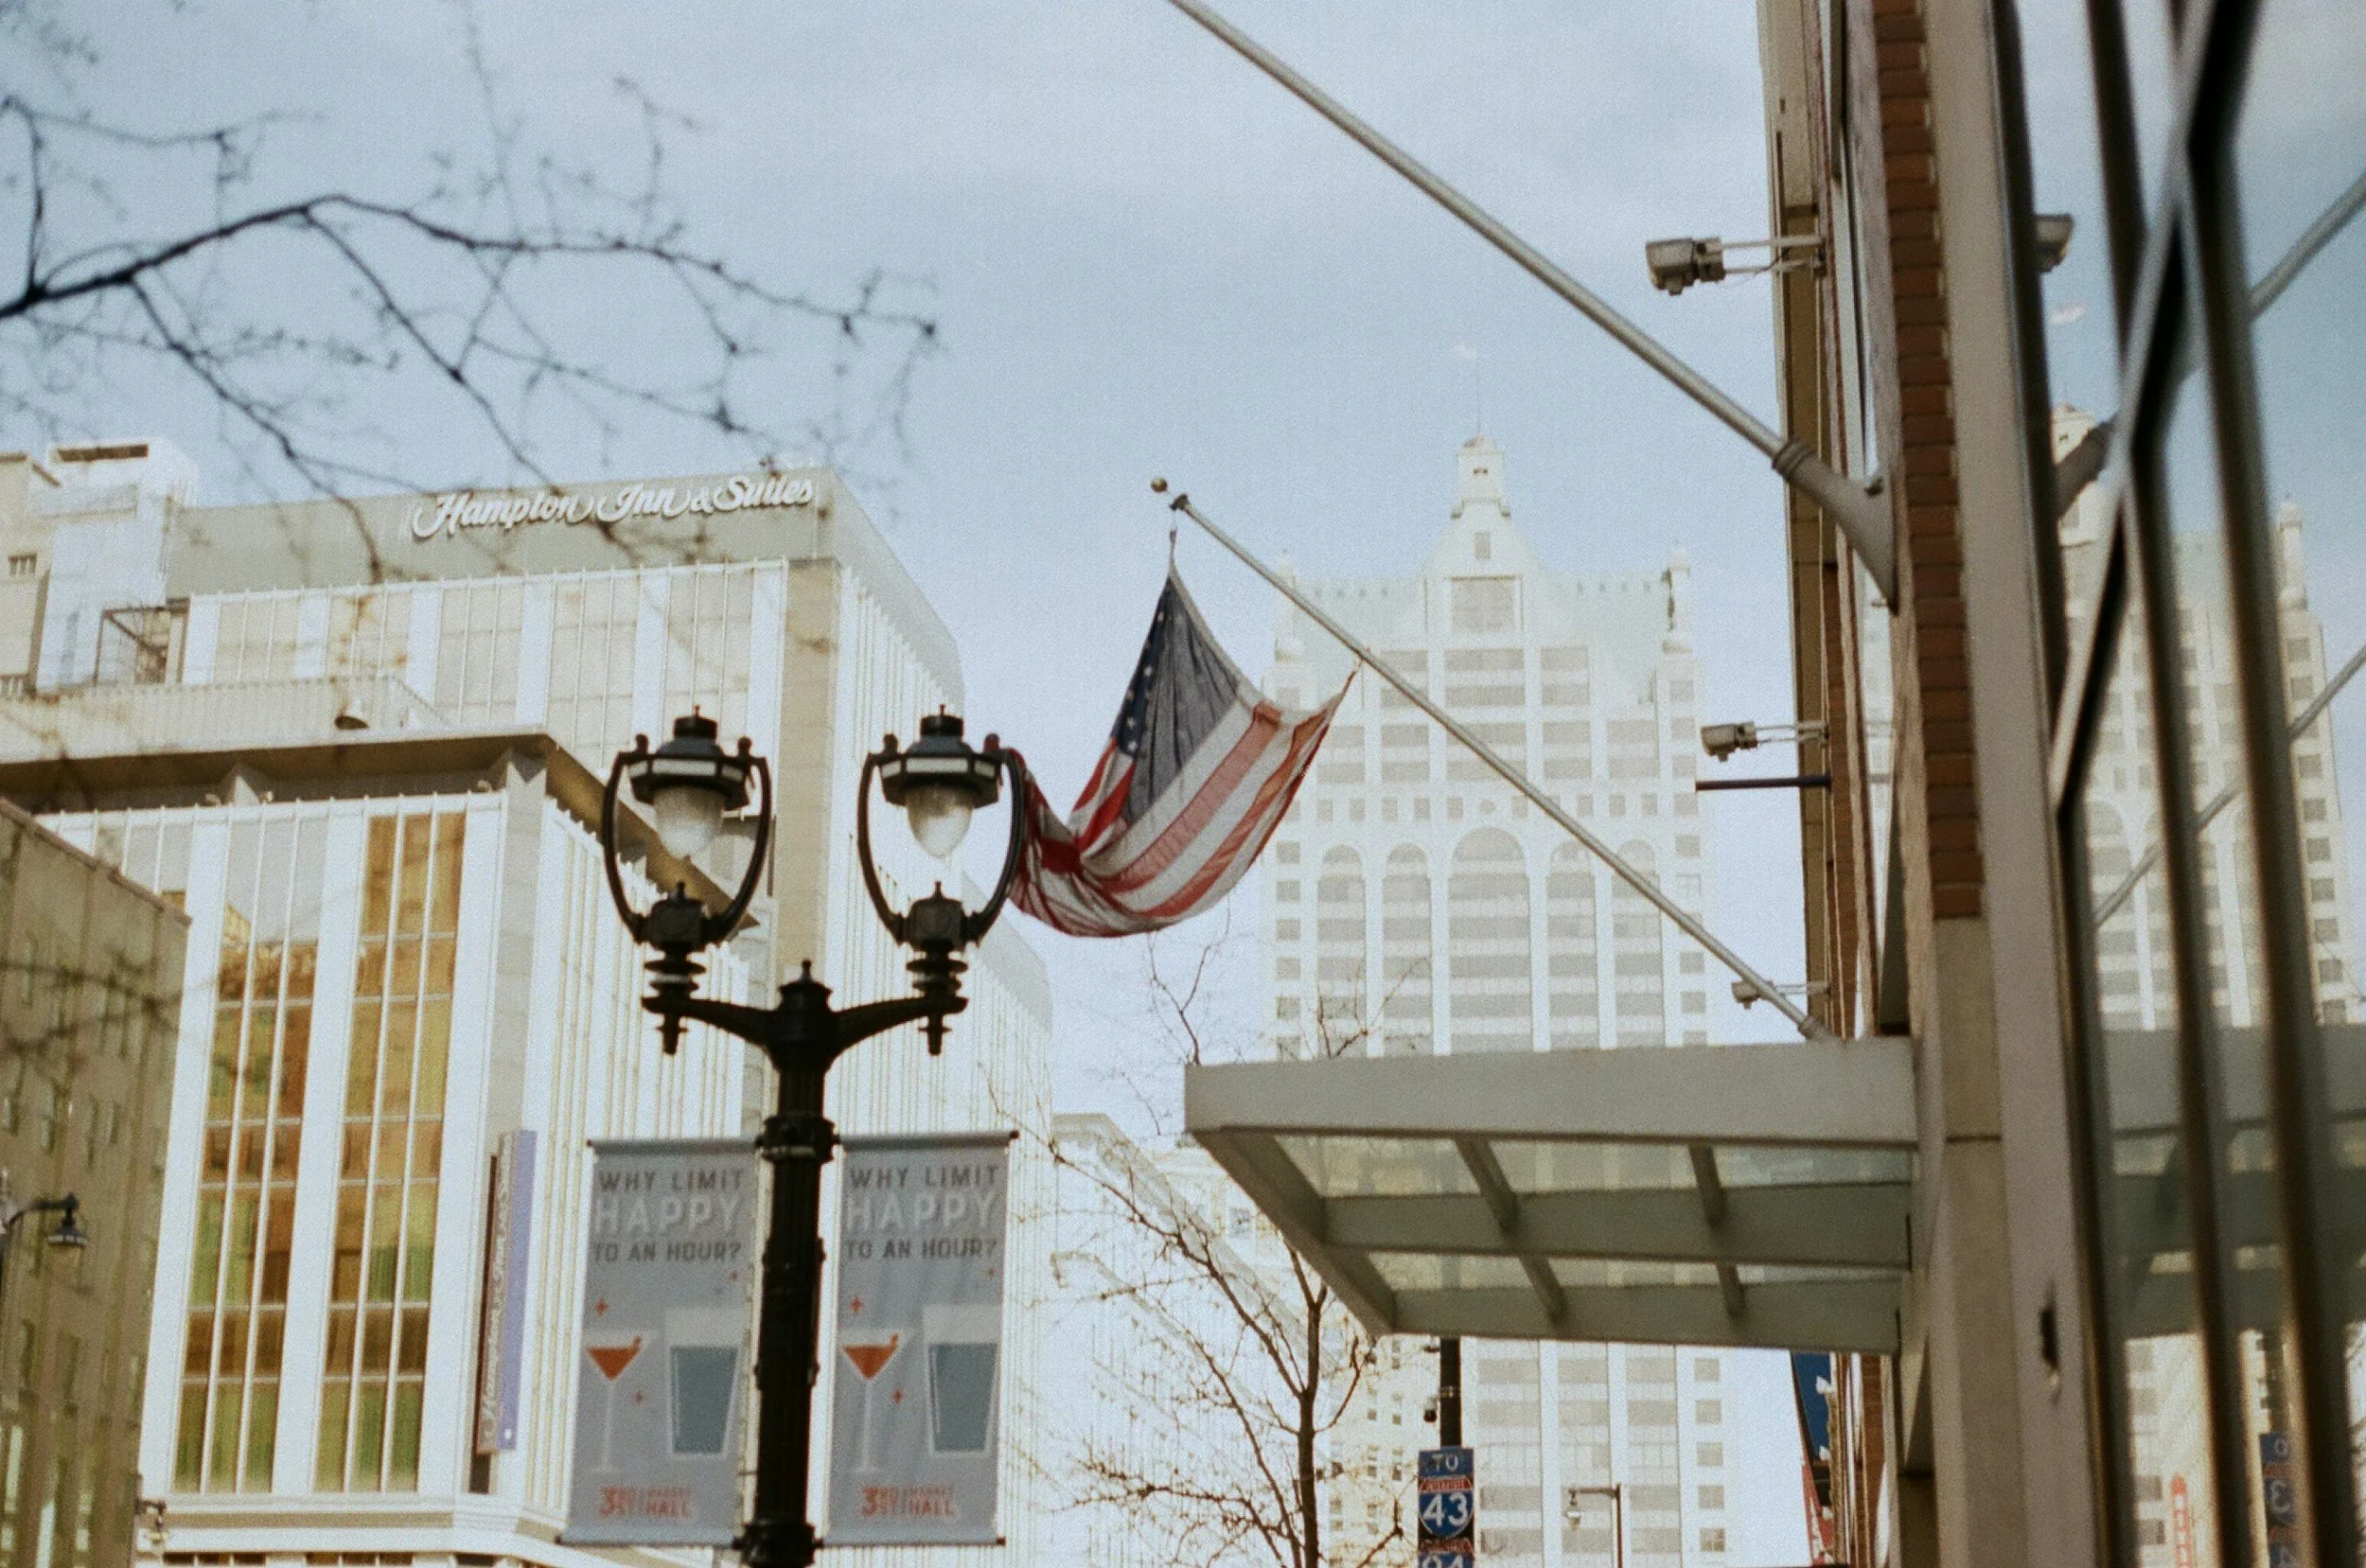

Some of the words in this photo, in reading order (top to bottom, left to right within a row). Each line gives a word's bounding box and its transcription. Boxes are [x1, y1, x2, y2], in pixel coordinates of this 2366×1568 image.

[412, 490, 594, 538] Hampton
[597, 483, 692, 521] Inn
[713, 475, 814, 511] Suites
[598, 1170, 656, 1191] WHY
[671, 1167, 744, 1191] LIMIT
[850, 1165, 909, 1189] WHY
[925, 1165, 998, 1188] LIMIT
[593, 1192, 743, 1232] HAPPY
[846, 1190, 998, 1230] HAPPY
[593, 1242, 619, 1261] TO
[629, 1242, 656, 1261] AN
[666, 1241, 742, 1261] HOUR?
[846, 1240, 873, 1260] TO
[882, 1239, 912, 1260] AN
[921, 1237, 998, 1260] HOUR?
[1431, 1453, 1459, 1471] TO
[1422, 1492, 1468, 1526] 43
